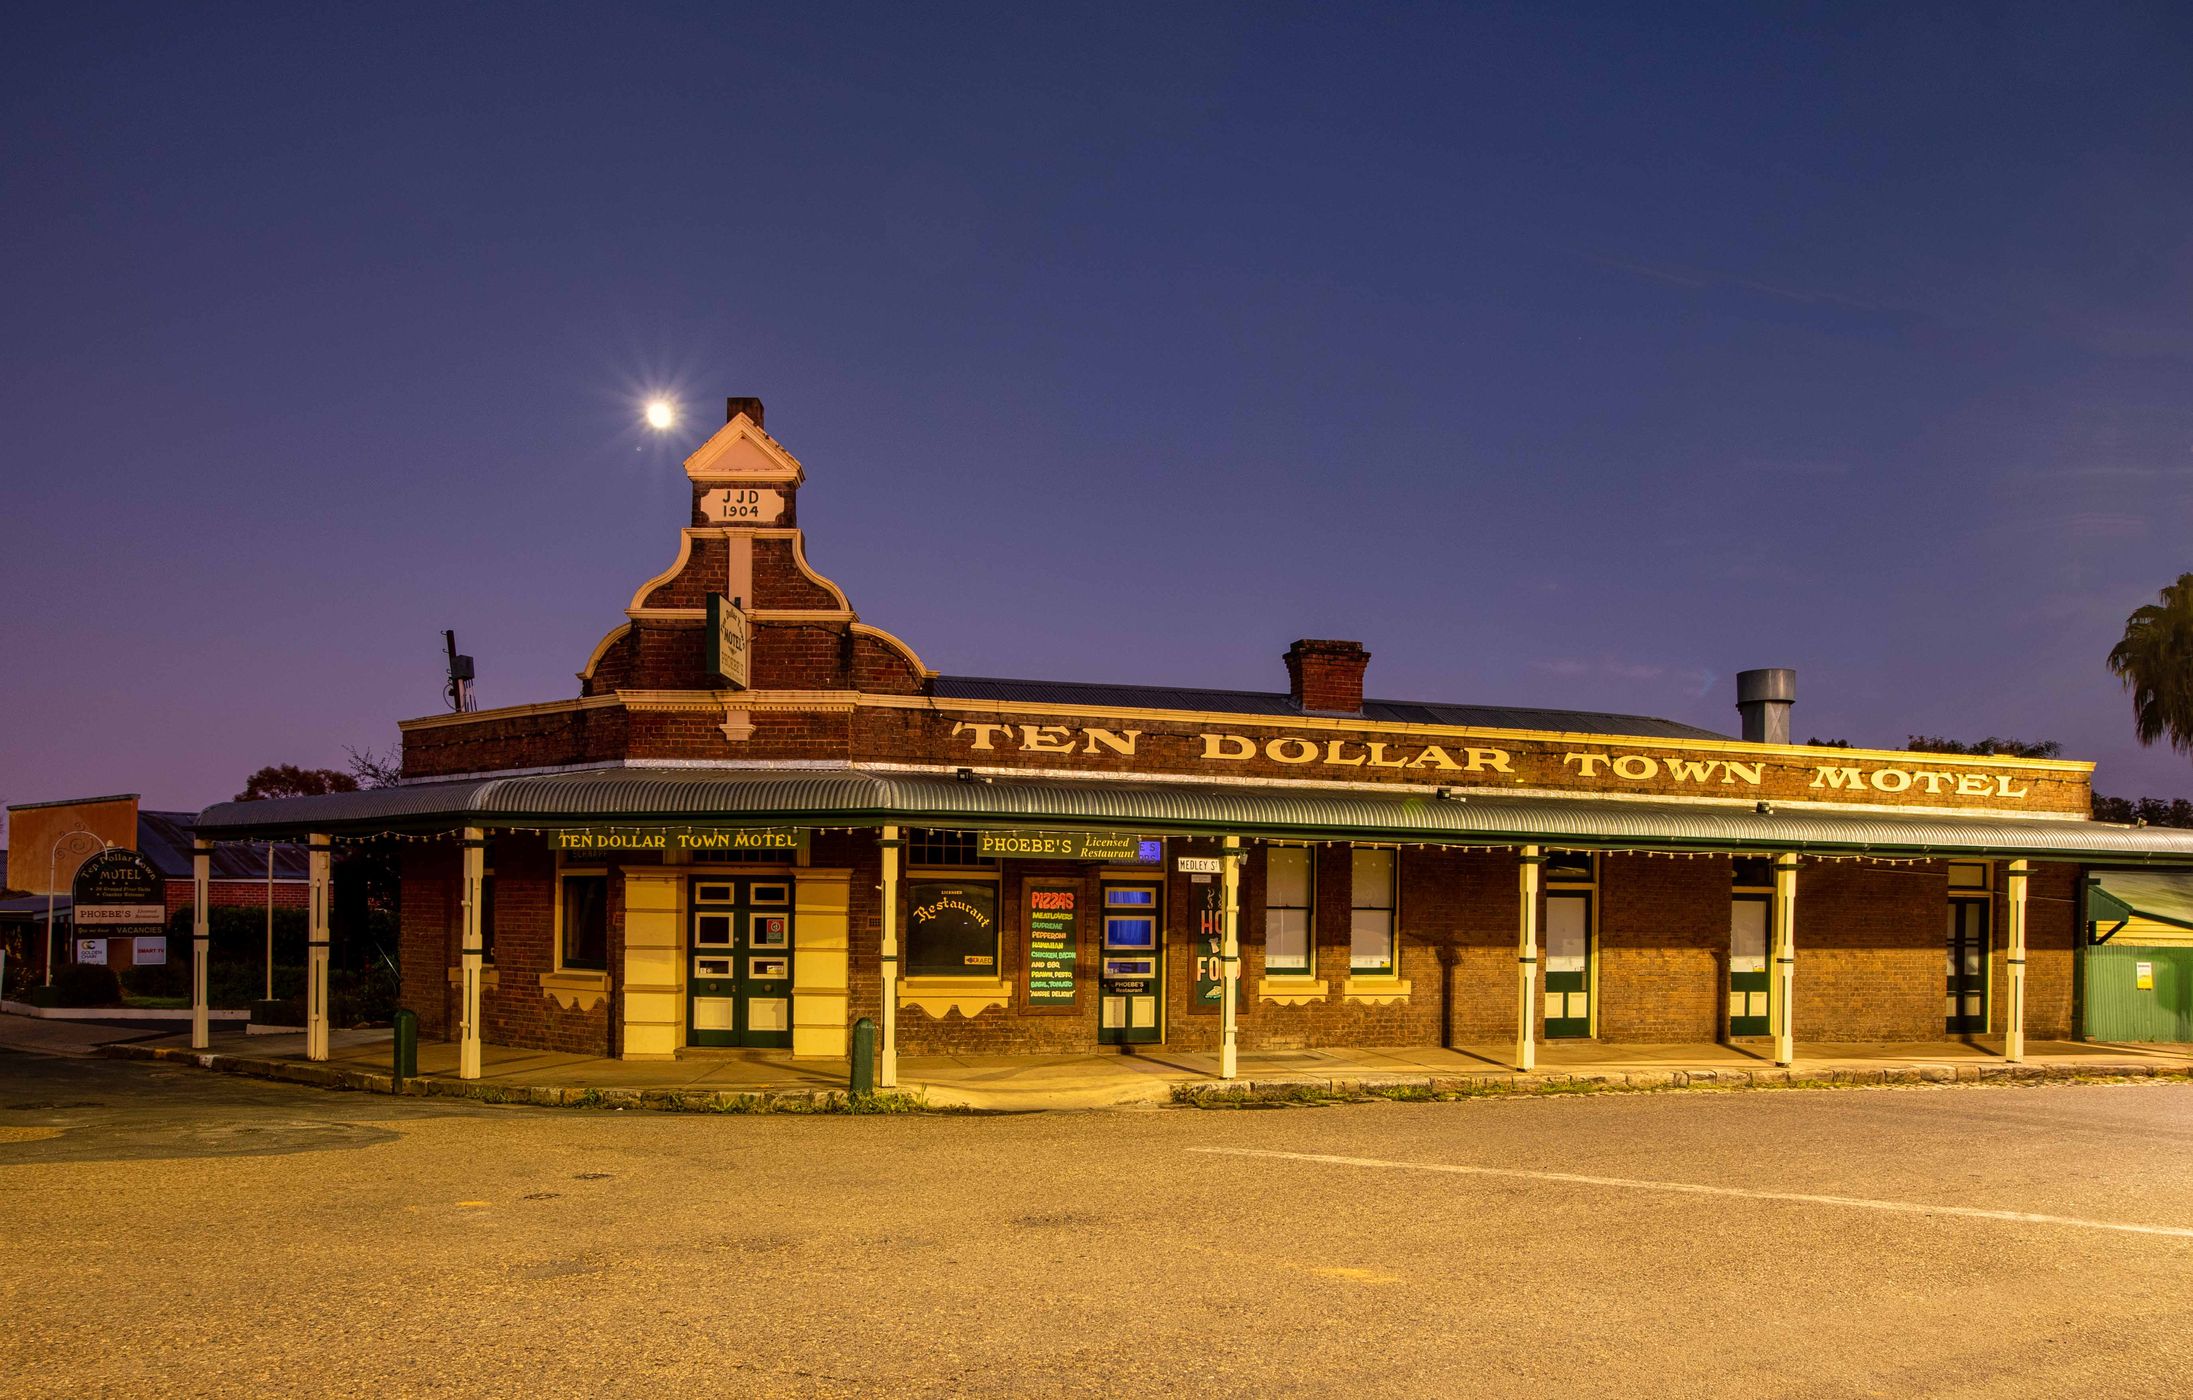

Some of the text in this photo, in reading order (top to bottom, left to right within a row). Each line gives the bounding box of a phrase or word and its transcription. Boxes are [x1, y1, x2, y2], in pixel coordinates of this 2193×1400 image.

[723, 505, 759, 517] 1904
[724, 629, 743, 652] MOTEL
[952, 721, 2029, 799] TEN DOLLAR TOWN MOTEL
[558, 834, 798, 848] TEN DOLLAR TOWN MOTEL
[982, 837, 1131, 854] PHOEBE'S Licensed
[1079, 847, 1135, 859] Restaurant
[1180, 860, 1208, 871] MEDLEY
[1031, 891, 1074, 910] PIZZAS
[80, 910, 132, 918] PHOEBE'S
[913, 896, 990, 928] Restaurant
[1032, 911, 1073, 920] MEATLOVERS
[116, 926, 163, 934] VACANCIES
[1031, 921, 1064, 930] SUPREME
[1031, 931, 1067, 940] PEPPERONI
[1031, 941, 1064, 949] HAWAIIAN
